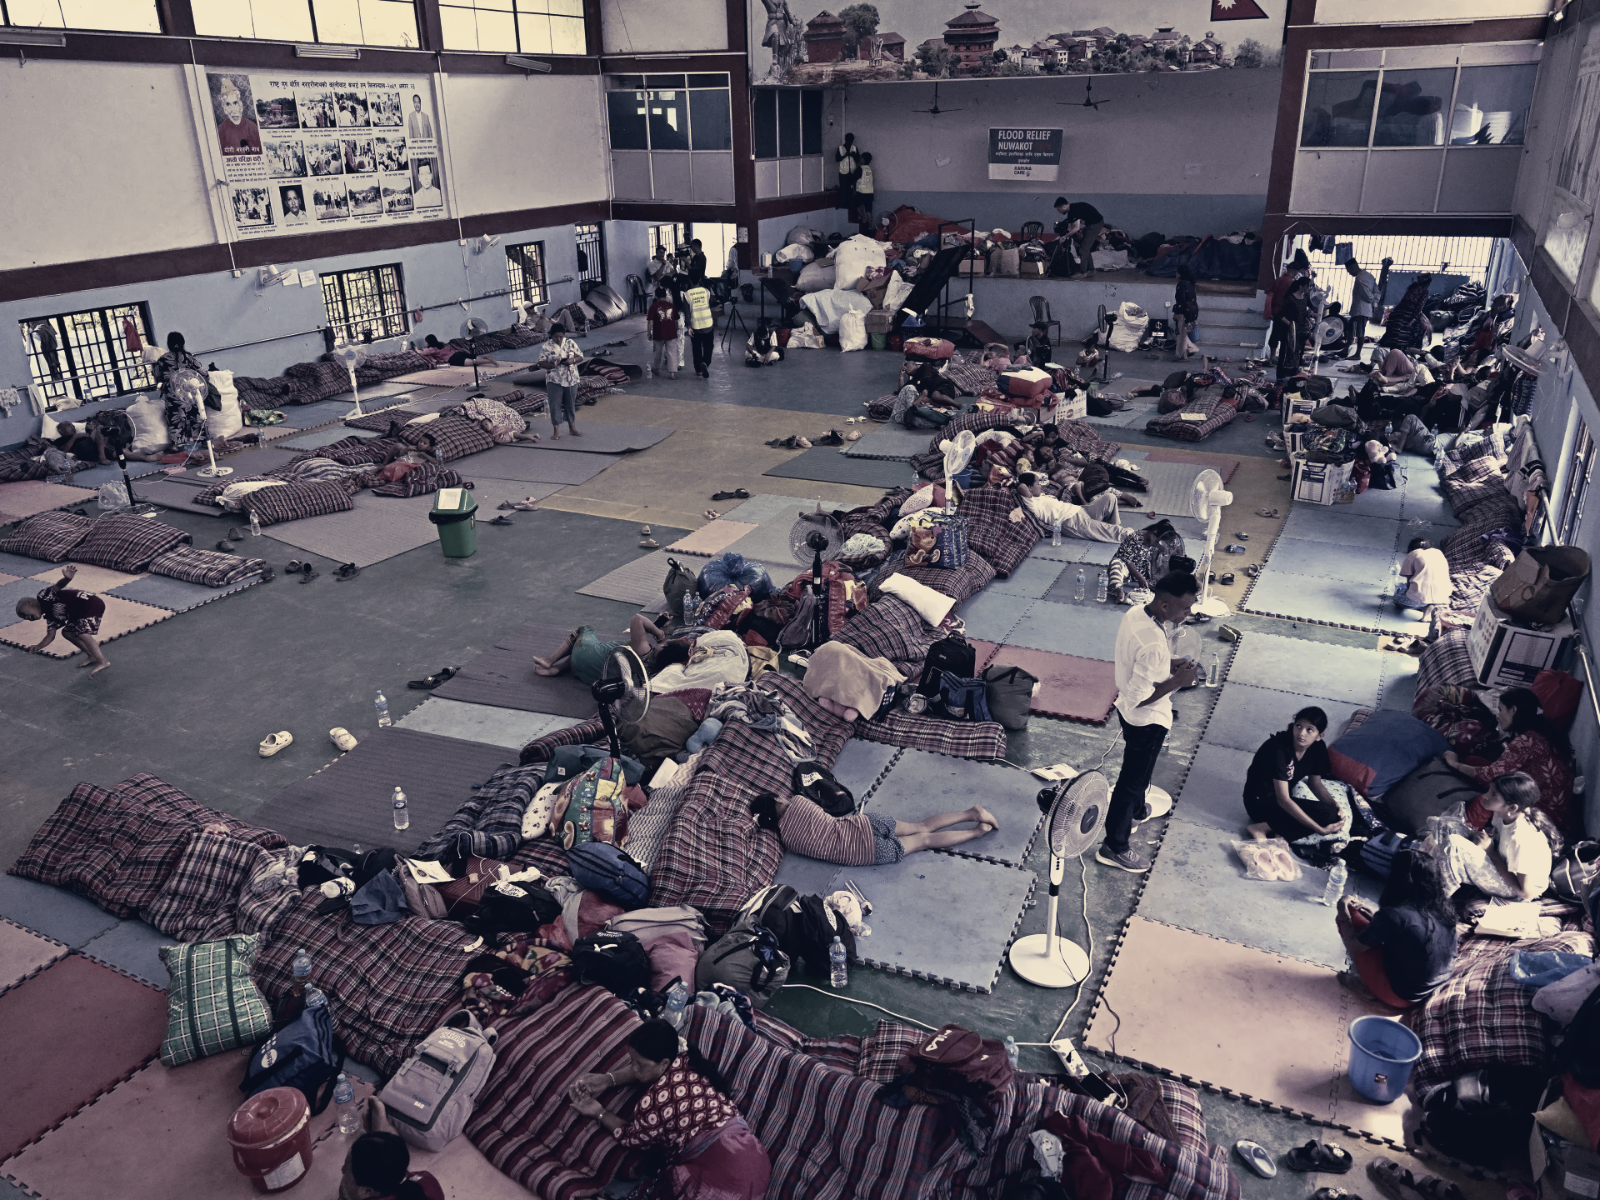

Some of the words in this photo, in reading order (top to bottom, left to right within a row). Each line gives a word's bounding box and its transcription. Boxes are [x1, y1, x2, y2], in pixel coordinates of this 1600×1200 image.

[998, 130, 1024, 140] FLOOD
[1026, 130, 1051, 140] RELIEF
[998, 141, 1033, 151] NUWAKOT
[925, 1029, 953, 1052] FILA
